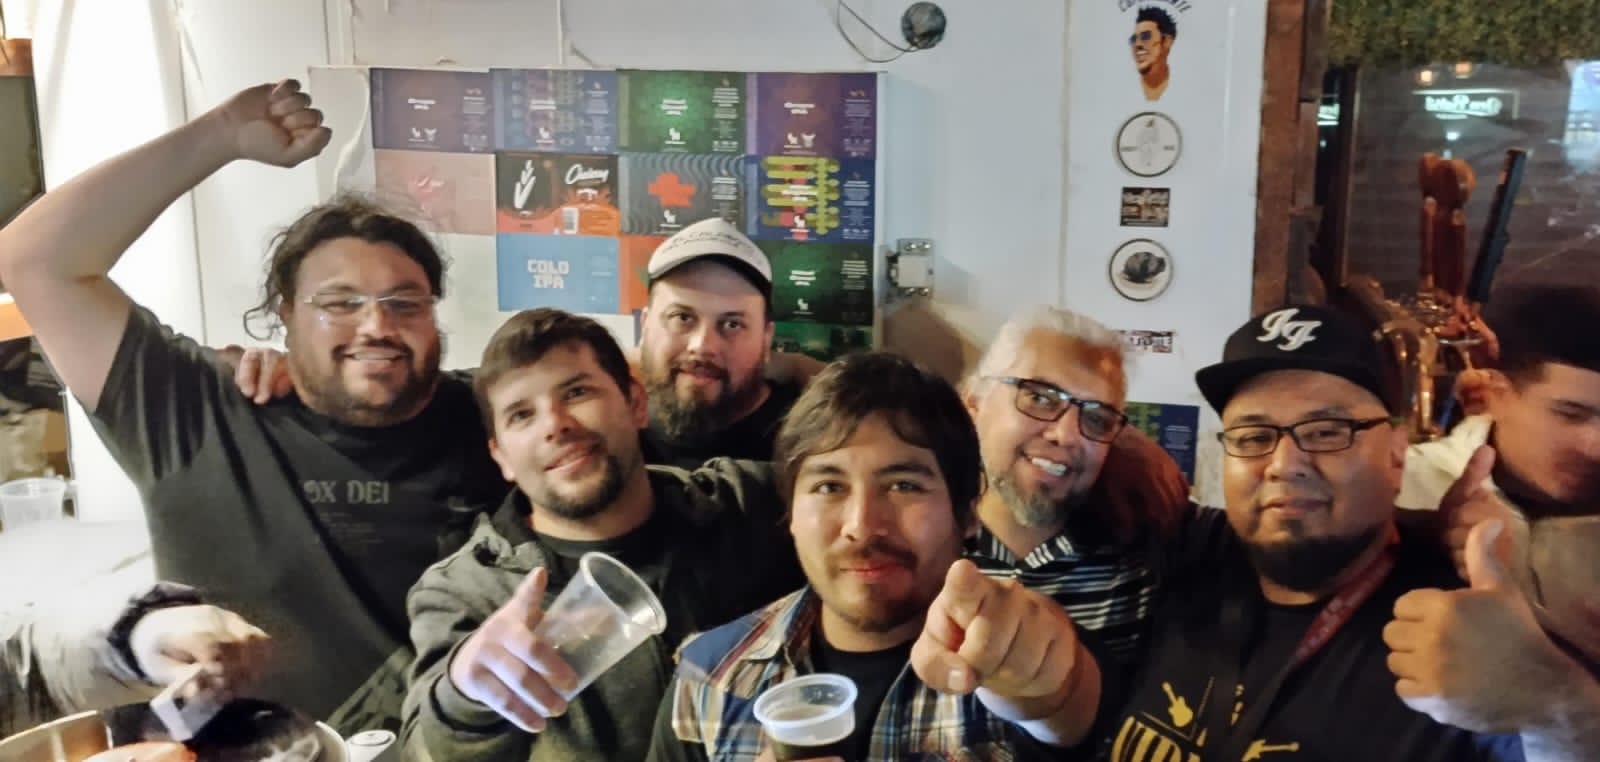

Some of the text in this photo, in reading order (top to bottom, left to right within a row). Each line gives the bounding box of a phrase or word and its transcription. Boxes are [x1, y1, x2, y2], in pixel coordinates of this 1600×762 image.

[528, 259, 569, 274] COLD
[533, 274, 564, 289] IPA
[347, 479, 389, 504] DEI
